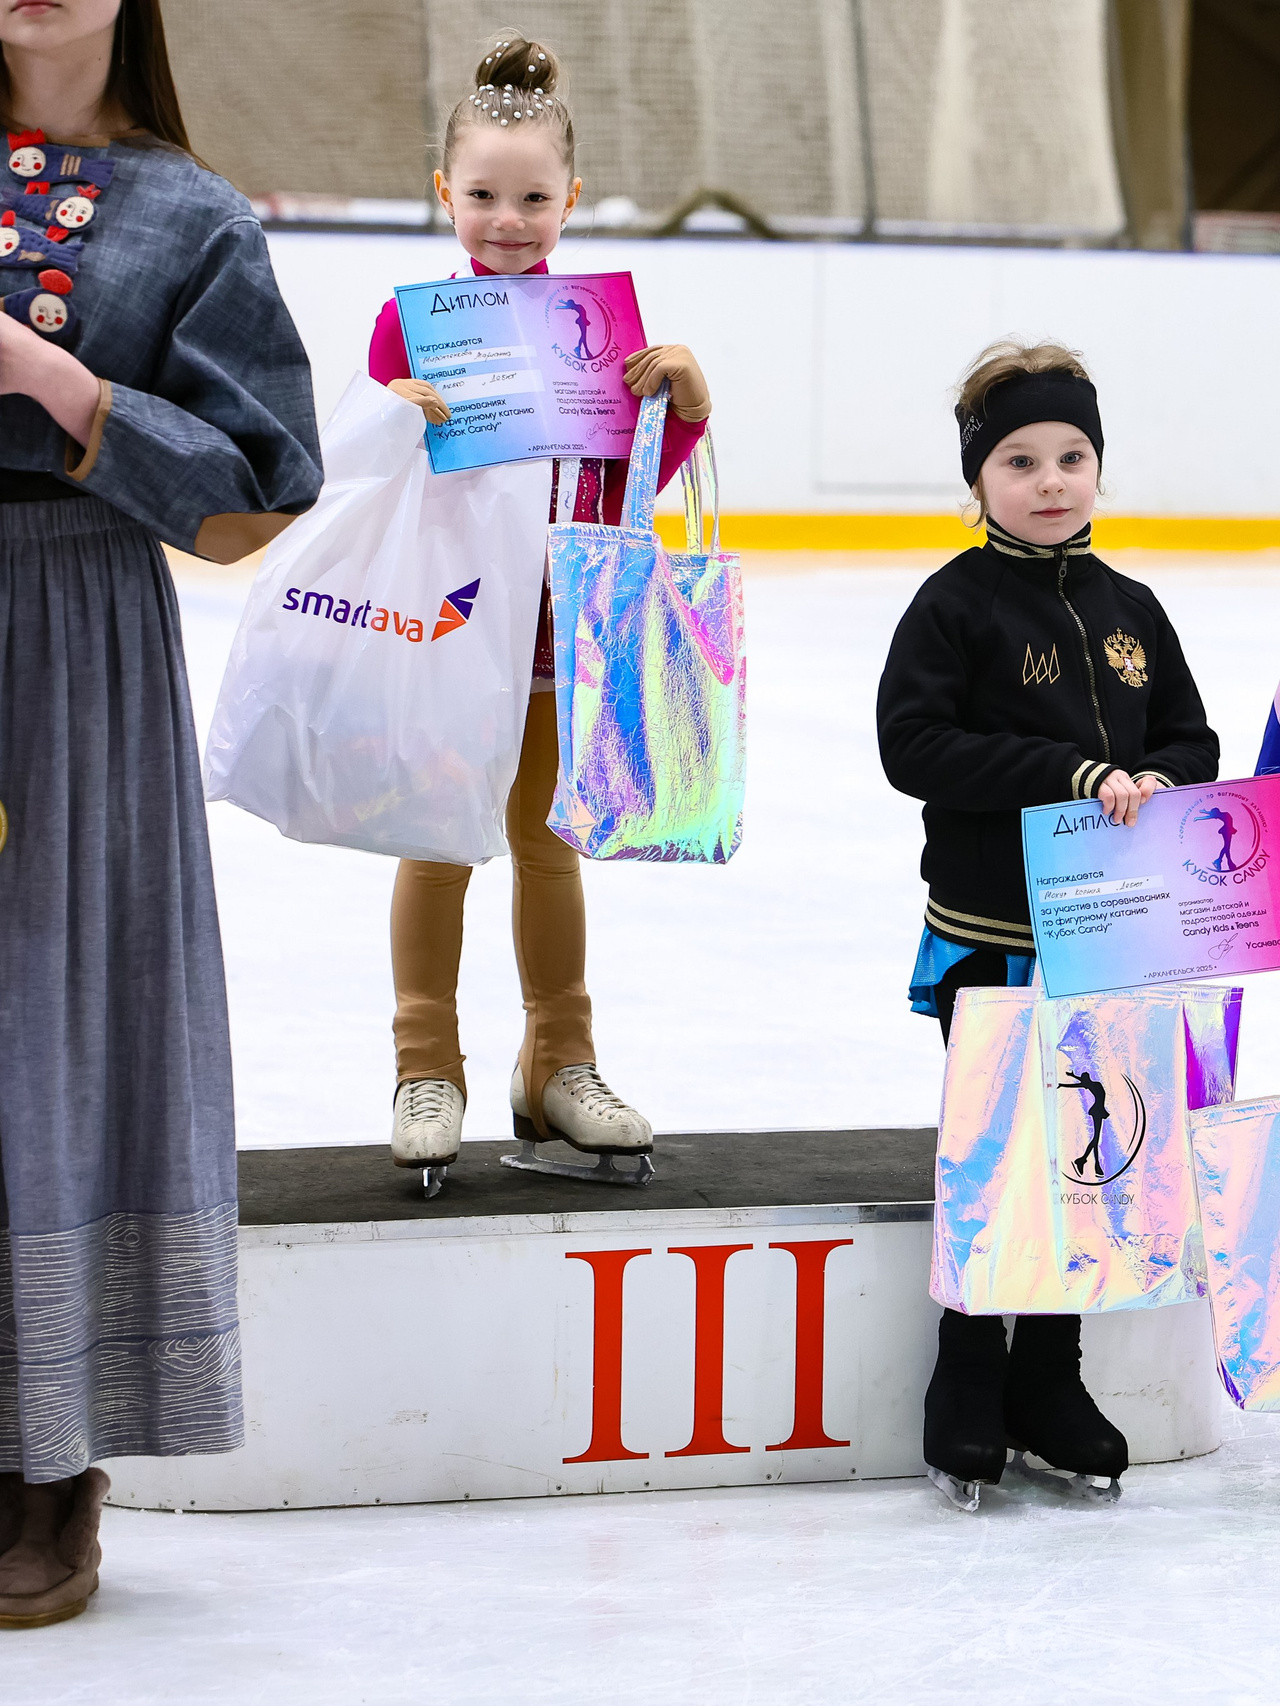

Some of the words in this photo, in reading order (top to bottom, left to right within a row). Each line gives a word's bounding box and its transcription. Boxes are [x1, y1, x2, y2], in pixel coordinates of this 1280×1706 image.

[415, 337, 483, 353] Награждается
[551, 343, 588, 374] КУБОК
[590, 341, 622, 373] CANDY
[422, 367, 467, 381] занявшая
[448, 399, 507, 414] ревнованиях
[499, 407, 535, 417] катанию
[558, 407, 580, 416] Candy
[580, 407, 593, 415] Kids
[596, 407, 616, 415] Teens
[281, 587, 424, 643] smartava
[1182, 859, 1227, 886] КУБОК
[1233, 848, 1270, 884] CANDY
[1036, 870, 1104, 887] Награждается
[1040, 907, 1052, 916] за
[1053, 903, 1091, 916] участие
[1100, 892, 1171, 908] соревнованиях
[1180, 907, 1211, 916] магазин
[1212, 901, 1243, 912] детской
[1042, 920, 1054, 928] по
[1055, 912, 1108, 926] фигурному
[1110, 907, 1148, 918] катанию
[1181, 912, 1236, 926] подростковой
[1236, 909, 1267, 918] одежды
[1182, 926, 1211, 937] Candy
[1213, 923, 1229, 933] Kids
[1235, 920, 1260, 930] Teens
[1148, 967, 1195, 978] АРХАНГЕЛЬСК
[1060, 1193, 1098, 1205] КУБОК
[560, 1237, 855, 1465] III
